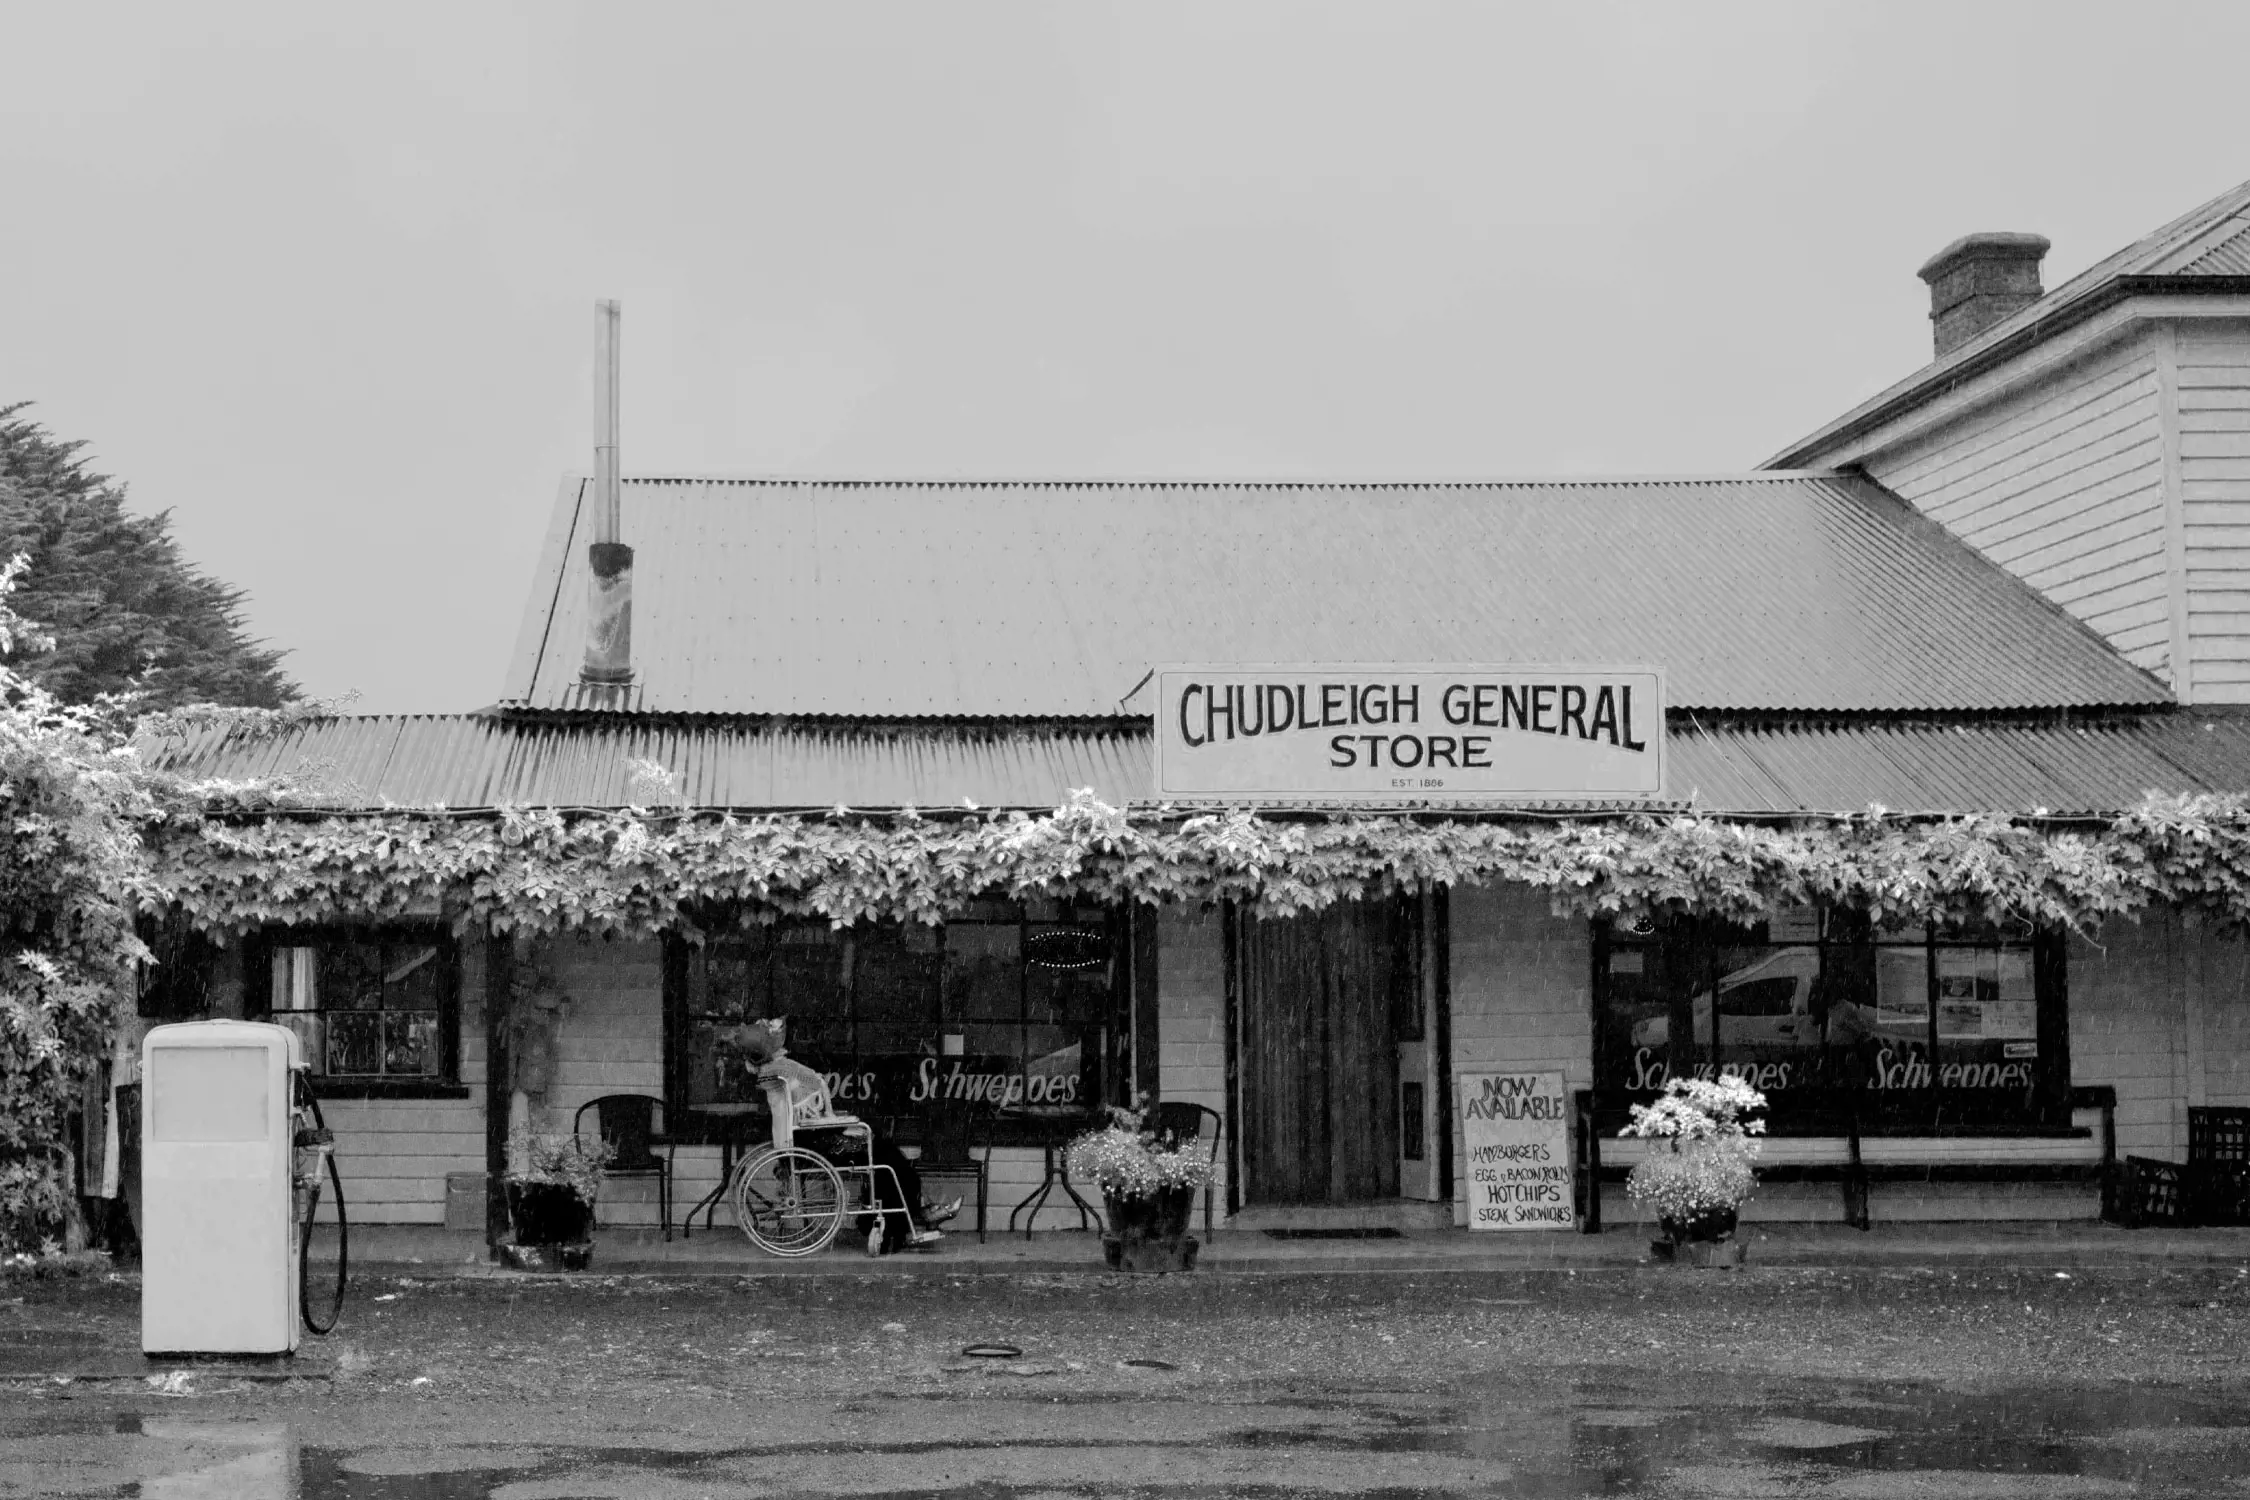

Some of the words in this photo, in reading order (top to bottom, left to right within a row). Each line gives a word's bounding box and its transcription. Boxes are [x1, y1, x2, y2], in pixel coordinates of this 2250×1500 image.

[1179, 683, 1419, 748] CHUDLEIGH
[1441, 683, 1646, 752] GENERAL
[1330, 734, 1493, 768] STORE
[909, 1057, 1080, 1105] Schweppes
[1481, 1076, 1536, 1101] NOW
[1464, 1096, 1565, 1121] AVAILABLE
[1473, 1143, 1551, 1164] HAMBURGERS
[1475, 1168, 1498, 1182] EGG
[1507, 1167, 1541, 1182] BACON
[1487, 1185, 1515, 1204] HOT
[1515, 1184, 1561, 1203] CHIPS
[1478, 1208, 1513, 1225] STEAK
